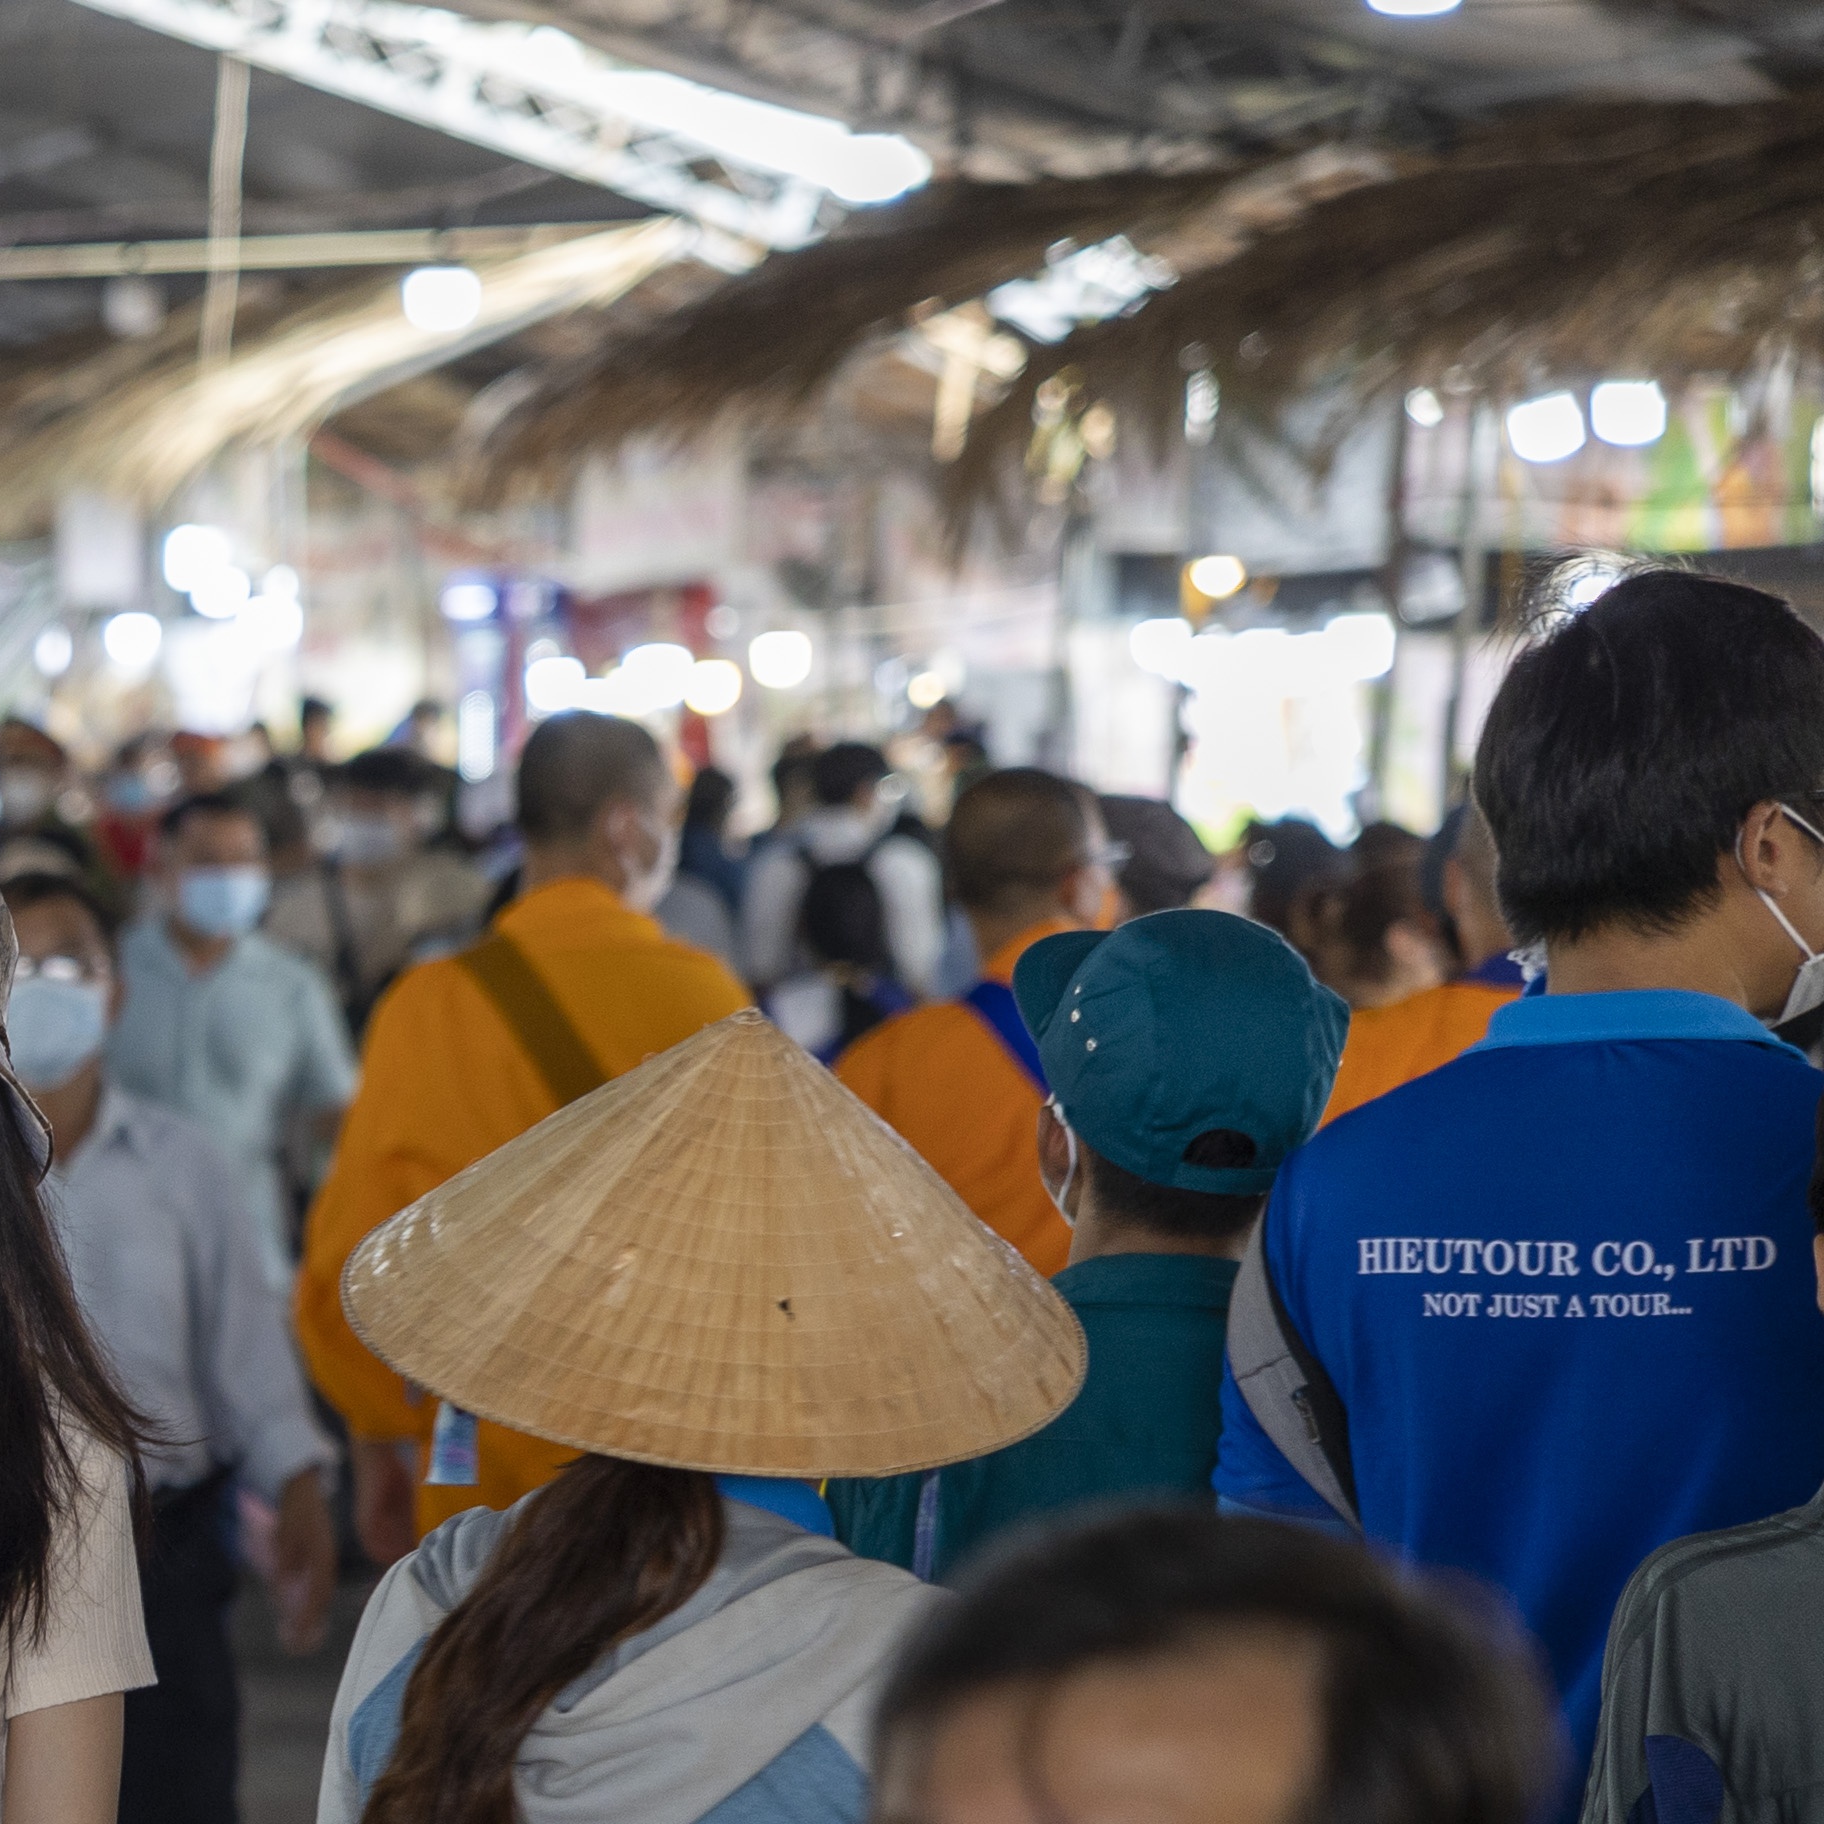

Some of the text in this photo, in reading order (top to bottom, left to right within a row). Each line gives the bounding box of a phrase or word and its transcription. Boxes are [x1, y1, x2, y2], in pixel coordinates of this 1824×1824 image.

[1356, 1236, 1778, 1281] HIEUTOUR CO., LTD
[1422, 1292, 1693, 1319] NOT JUST A TOUR...
